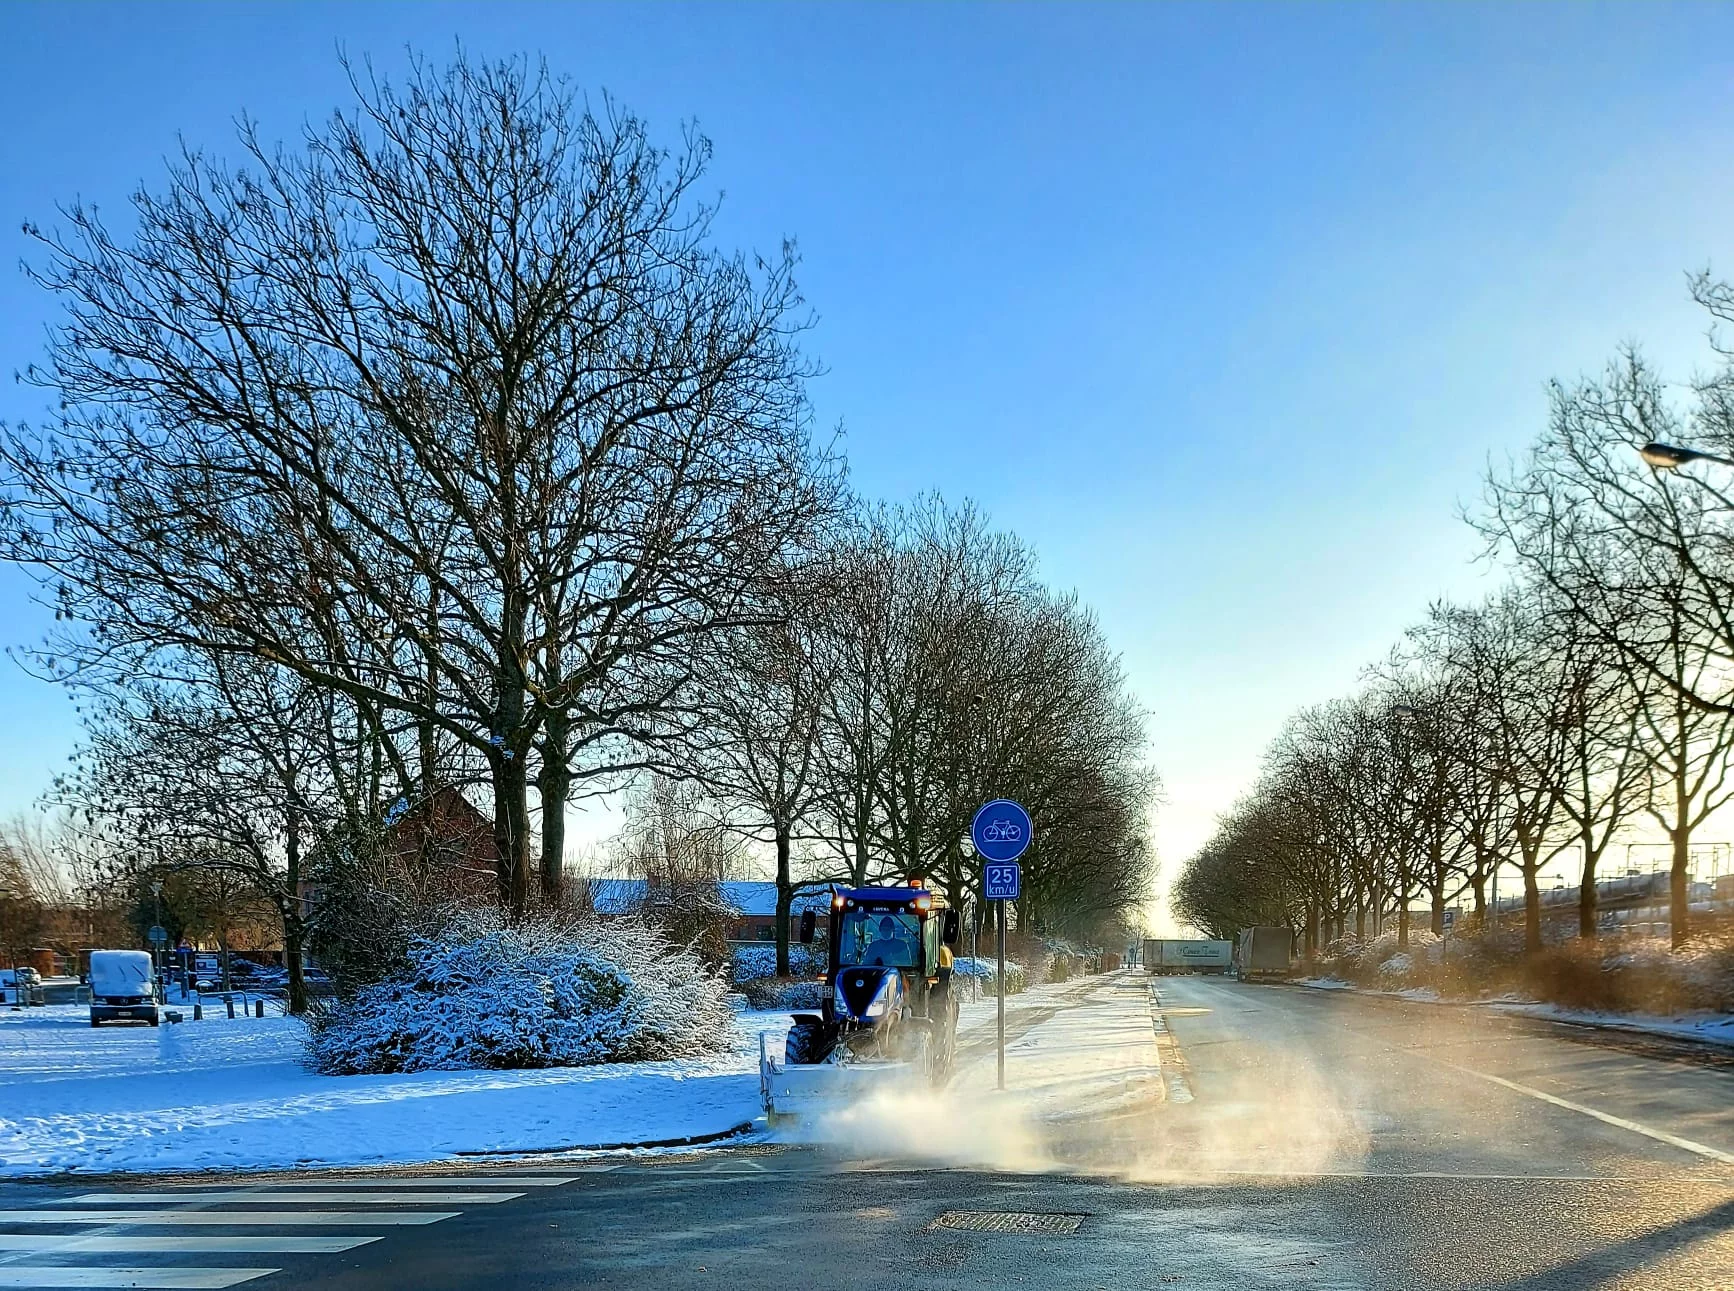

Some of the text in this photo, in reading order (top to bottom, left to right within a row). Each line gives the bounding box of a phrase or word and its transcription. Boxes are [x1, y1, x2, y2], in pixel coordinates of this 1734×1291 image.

[991, 868, 1013, 884] 25
[989, 884, 1015, 895] km/u
[1444, 913, 1451, 923] P
